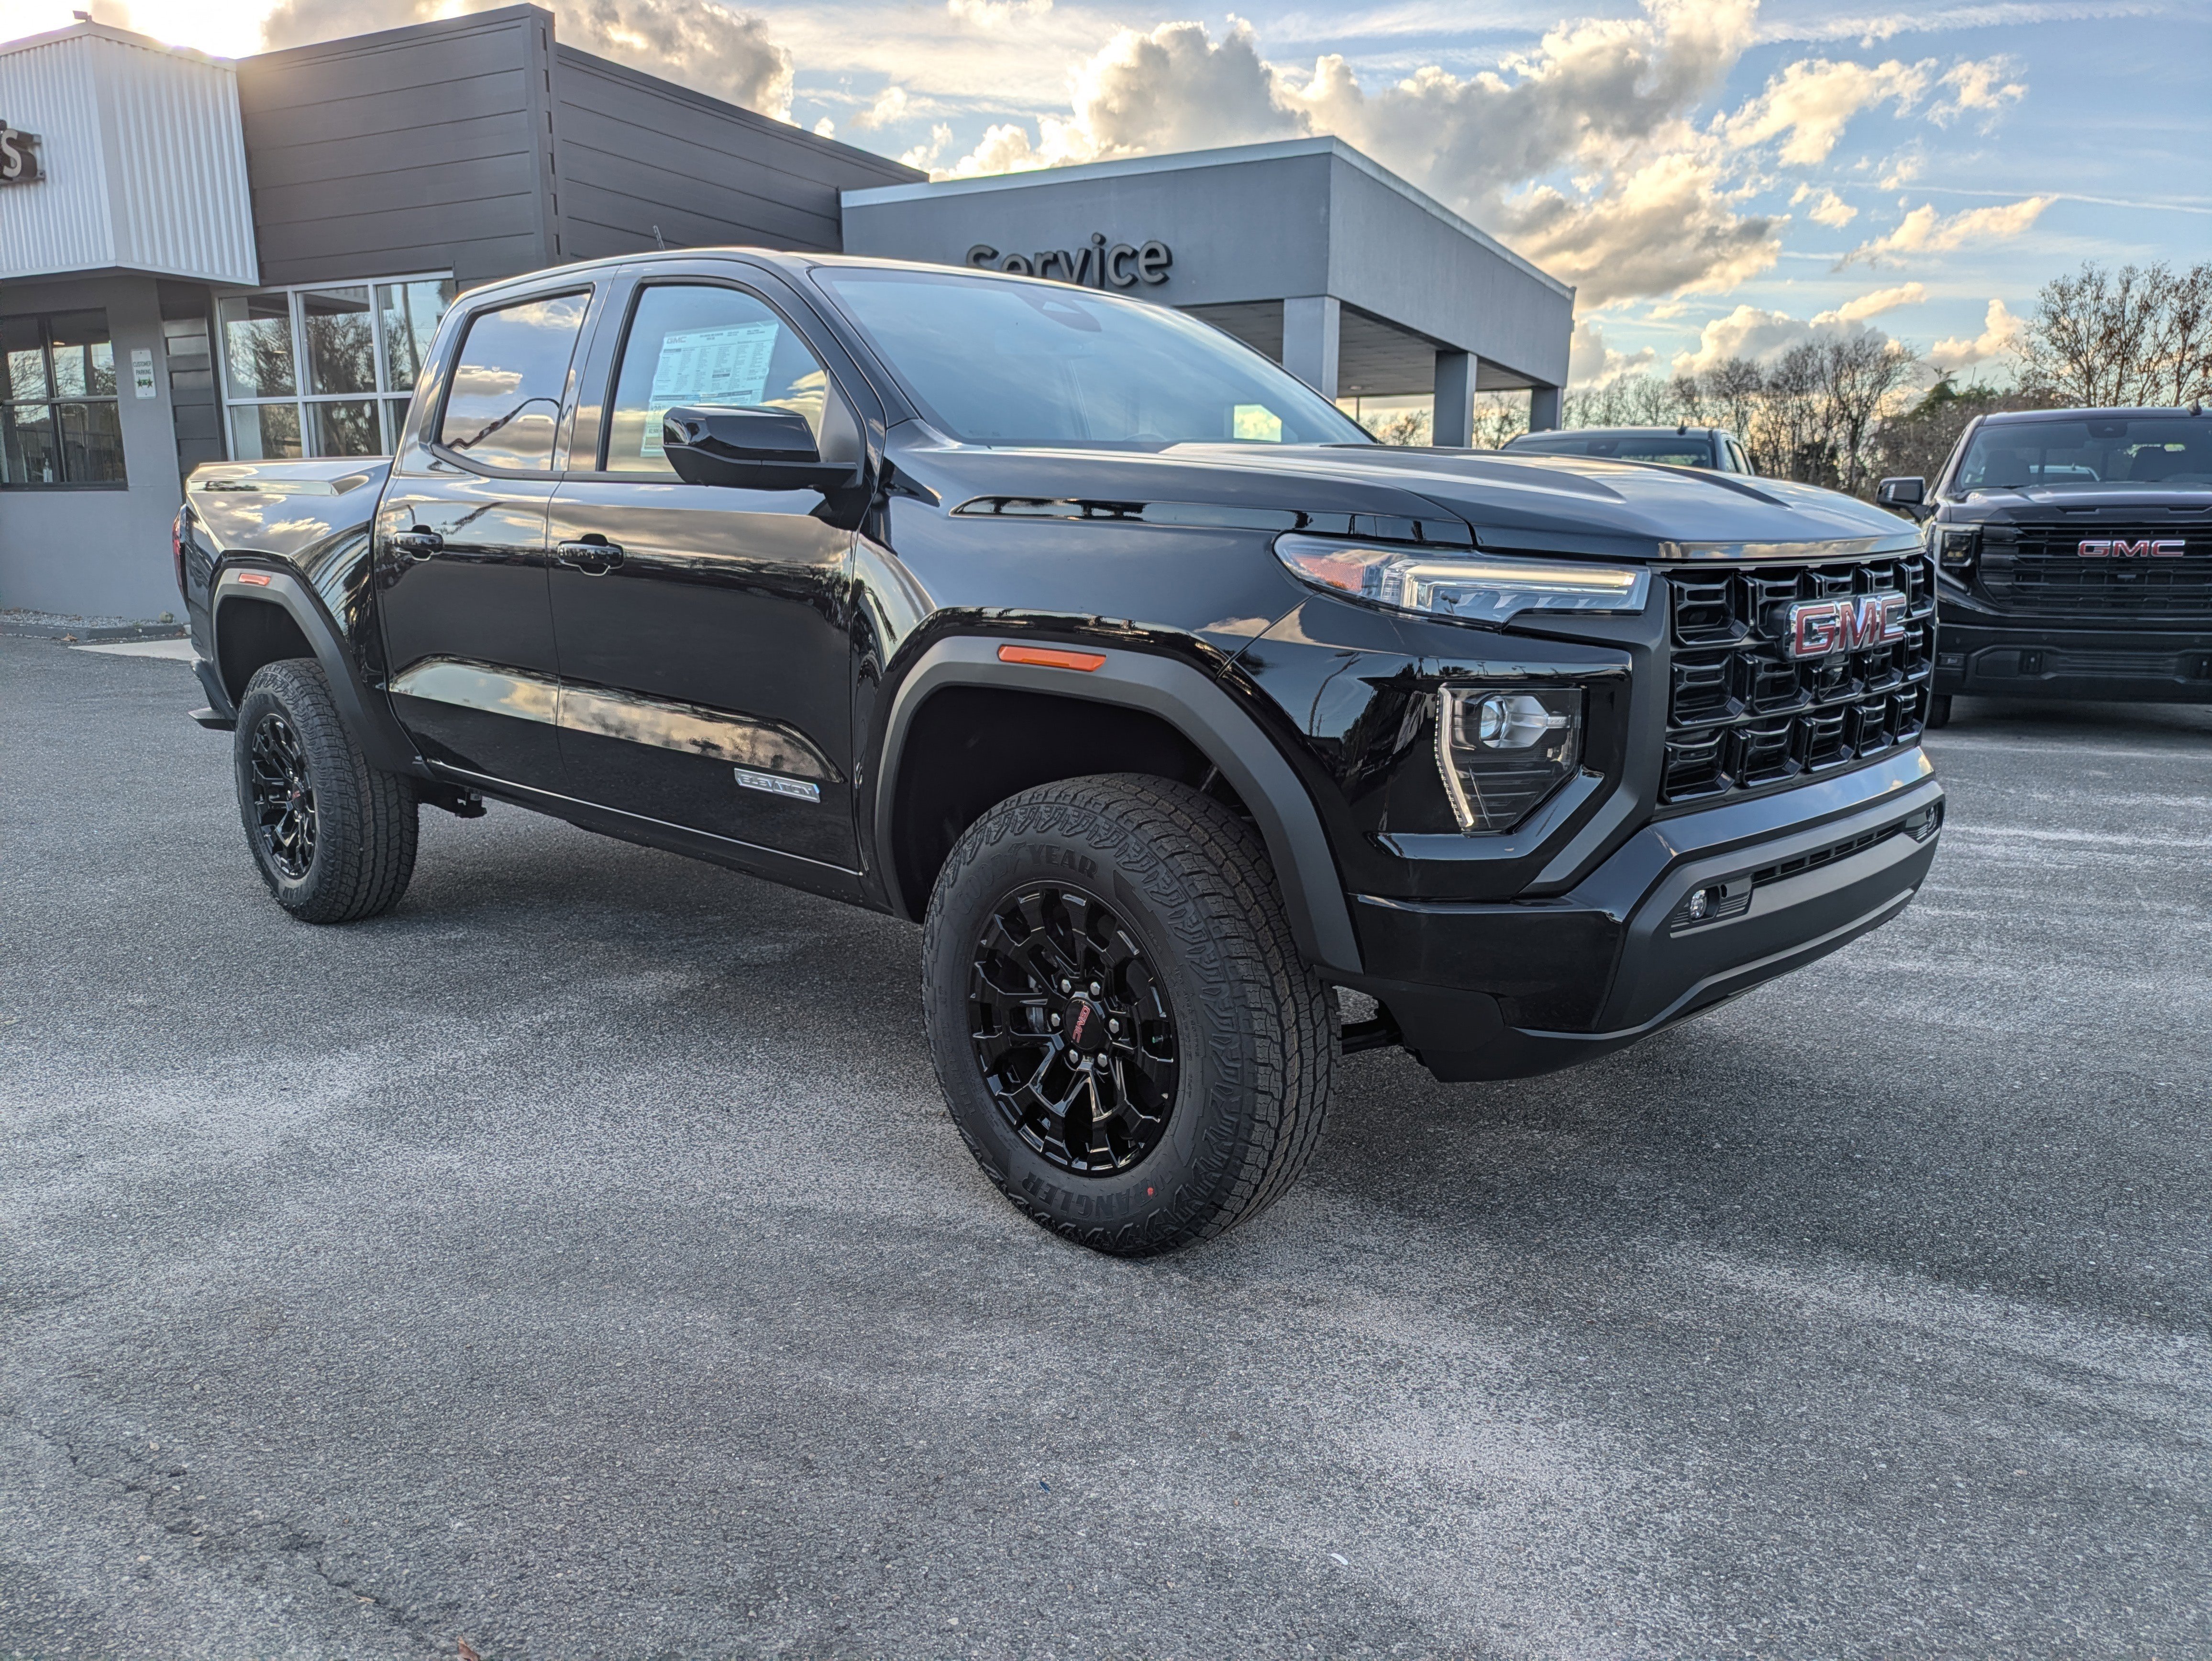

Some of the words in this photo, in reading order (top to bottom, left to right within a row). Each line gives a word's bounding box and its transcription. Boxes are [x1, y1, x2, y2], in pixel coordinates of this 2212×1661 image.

[2078, 540, 2186, 558] GMC
[1793, 592, 1907, 658] GMC
[738, 772, 815, 798] ELEVATION
[1072, 1005, 1090, 1043] GMC
[1022, 1161, 1174, 1218] WRANGLER
